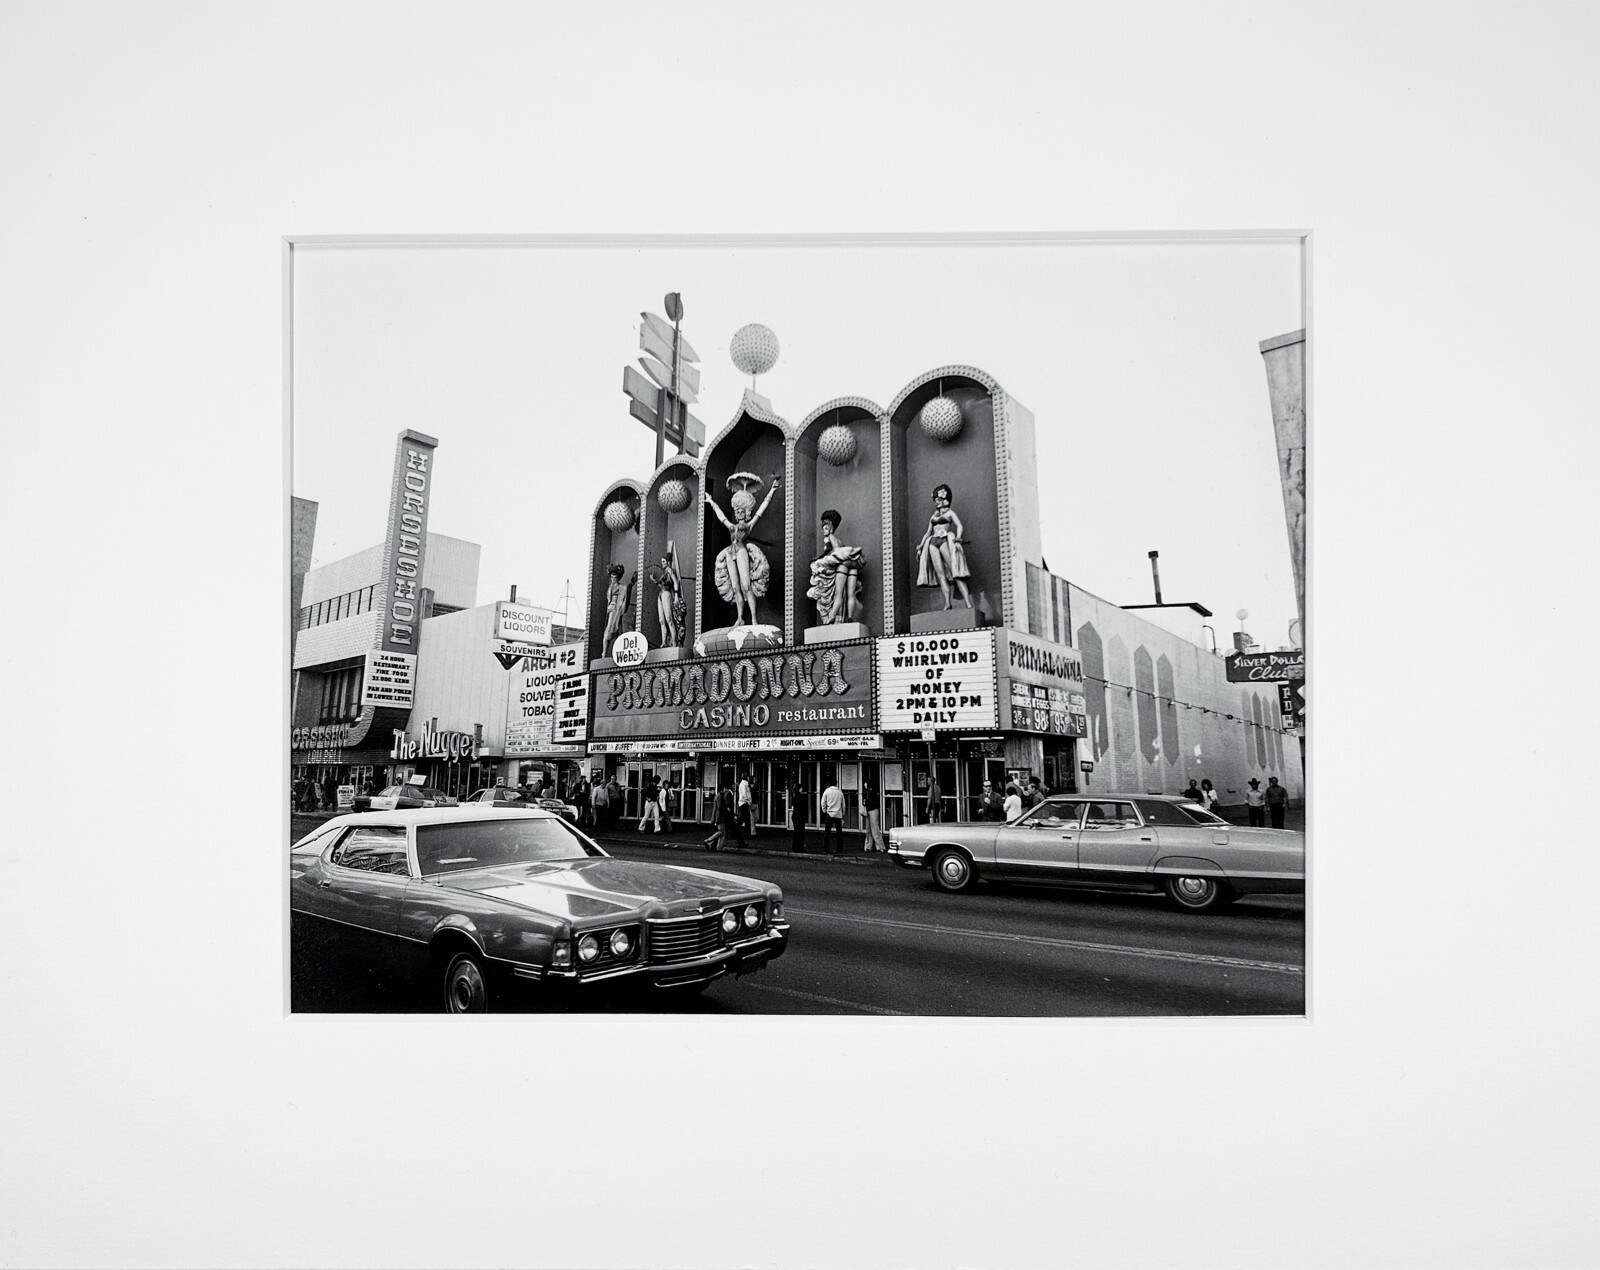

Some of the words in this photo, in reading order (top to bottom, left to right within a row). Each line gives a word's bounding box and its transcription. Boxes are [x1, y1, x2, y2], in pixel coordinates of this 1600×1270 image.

[390, 449, 428, 646] HORSESHOE
[502, 609, 550, 625] DISCOUNT
[504, 621, 546, 635] LIQUORS
[623, 636, 638, 650] Del
[500, 644, 546, 657] SOUVENIRS
[616, 647, 644, 663] Webb's
[373, 661, 411, 670] RESTAURANT
[892, 652, 979, 668] WHIRLWIND
[1009, 640, 1083, 683] PRIMADONNA
[1233, 657, 1267, 669] SILVER
[606, 648, 850, 711] PRIMADONNA
[925, 668, 944, 680] OF
[910, 681, 962, 695] MONEY
[928, 697, 938, 709] &
[680, 703, 770, 730] CASINO
[777, 703, 866, 722] restaurant
[913, 711, 957, 724] DAILY
[390, 728, 417, 760] The
[417, 720, 483, 763] Nugget
[714, 740, 736, 749] DINNER
[738, 739, 760, 748] BUFFET
